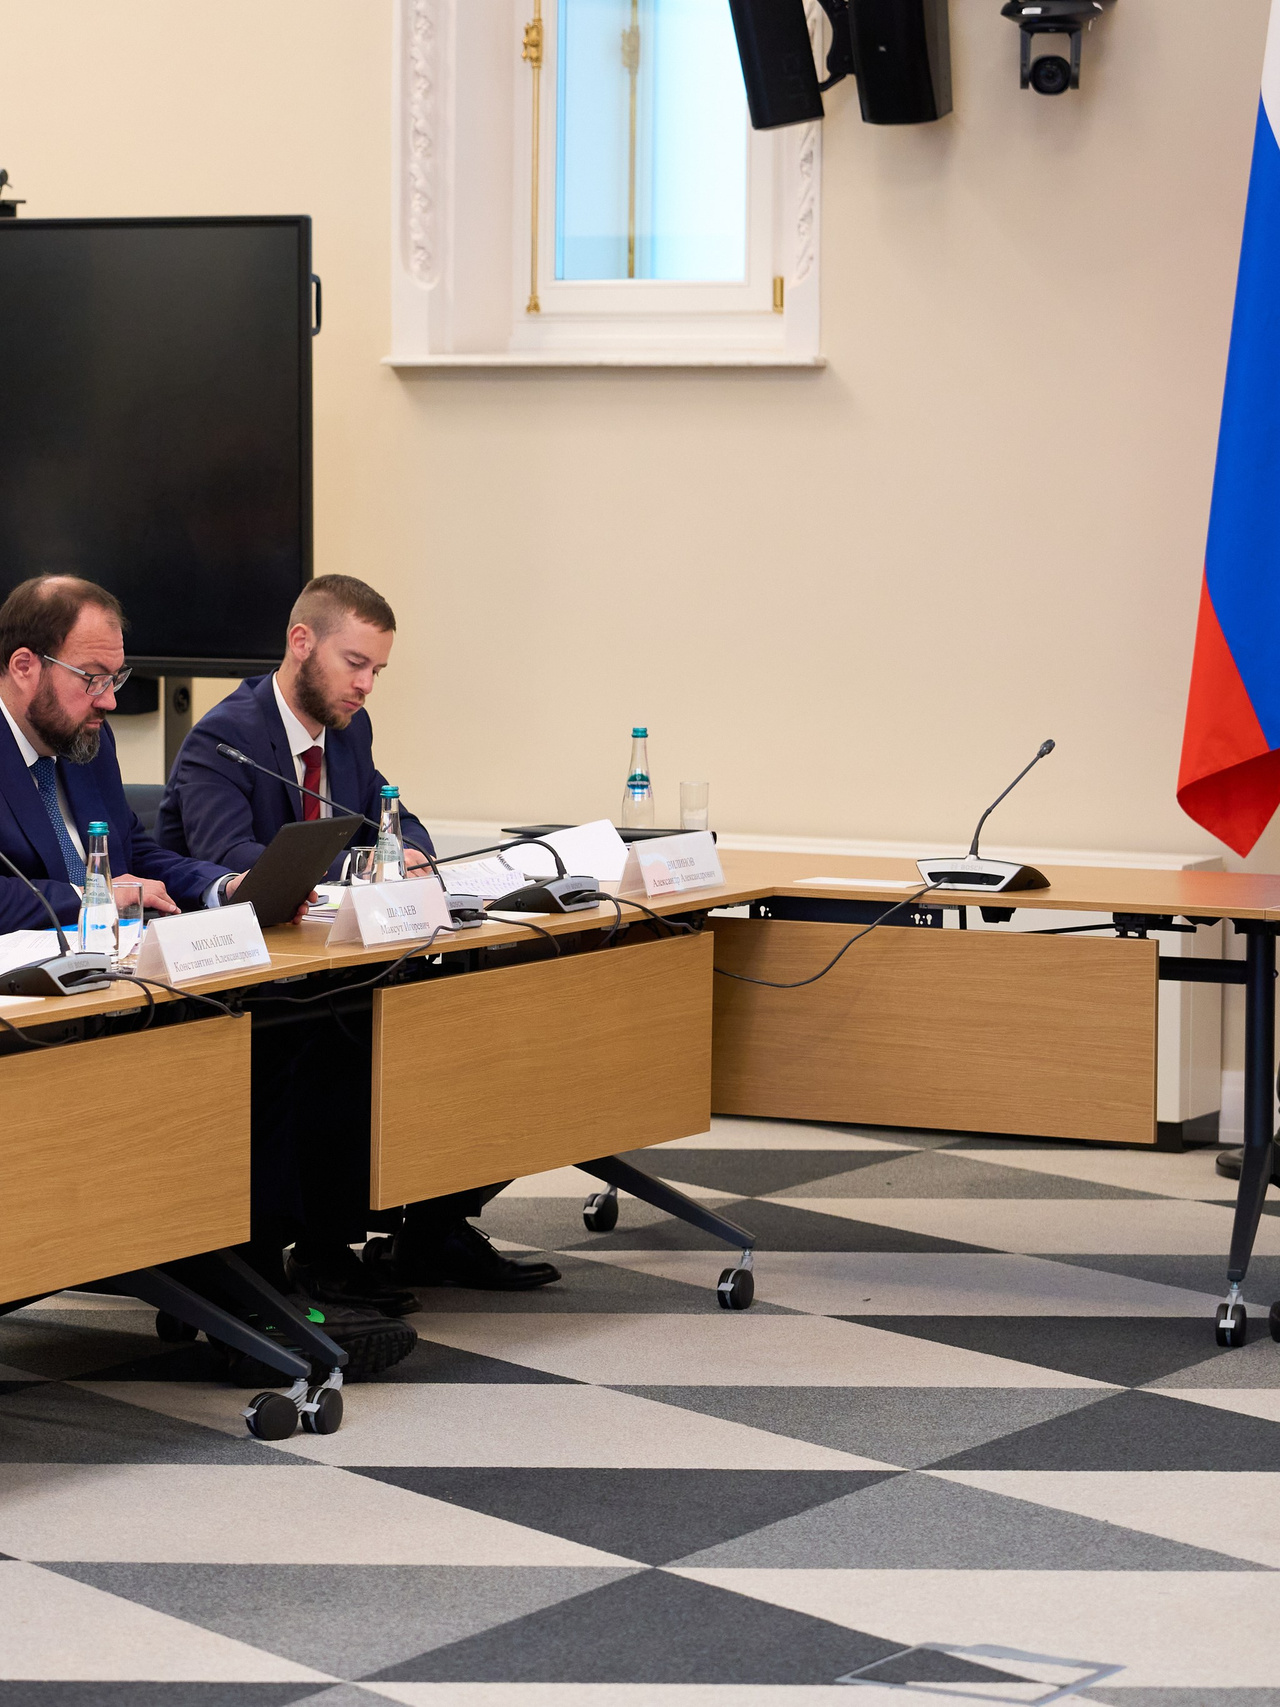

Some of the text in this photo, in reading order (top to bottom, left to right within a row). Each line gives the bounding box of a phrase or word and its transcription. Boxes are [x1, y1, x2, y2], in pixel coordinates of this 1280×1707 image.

[961, 863, 984, 871] BOSCH
[571, 882, 583, 890] BOSCH
[653, 870, 716, 888] Александр Александрович
[387, 906, 417, 919] ШАДАЕВ
[381, 921, 430, 936] Максут Игоревич
[192, 934, 236, 951] МИХАЙЛИК
[174, 949, 260, 972] Константин Александрович
